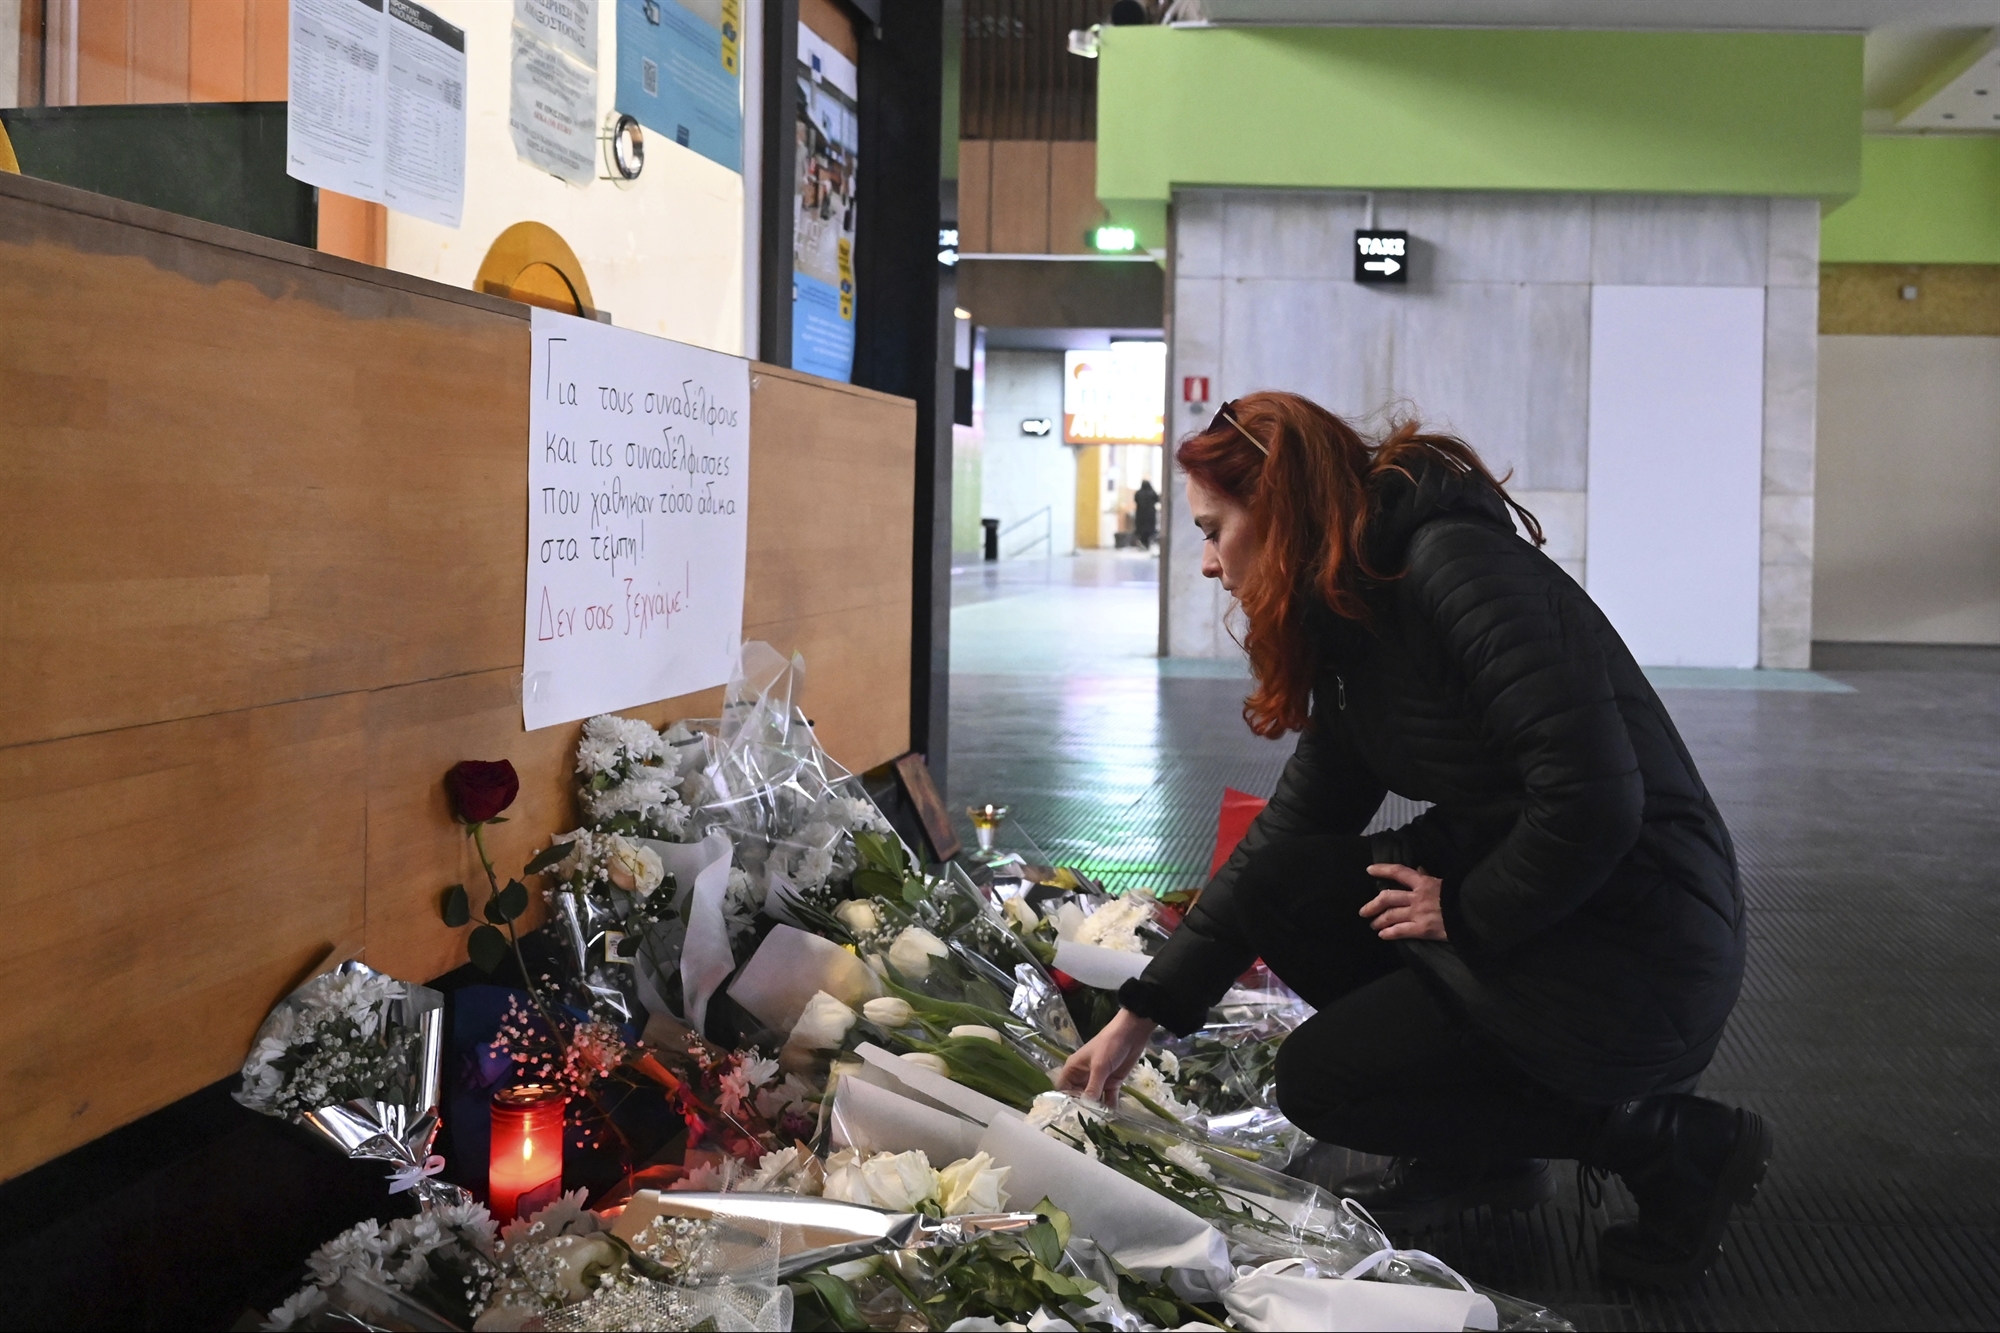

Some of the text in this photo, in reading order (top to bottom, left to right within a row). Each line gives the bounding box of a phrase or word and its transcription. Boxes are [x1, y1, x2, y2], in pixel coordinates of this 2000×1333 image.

[546, 338, 737, 436] Για τους συναδέλφους
[590, 440, 612, 467] τις
[626, 427, 730, 488] συναδέλφισσες
[591, 476, 654, 530] χάθηκαν
[698, 481, 736, 515] άδικα
[541, 538, 579, 563] στα
[539, 586, 576, 641] Δεν
[585, 603, 614, 631] σας
